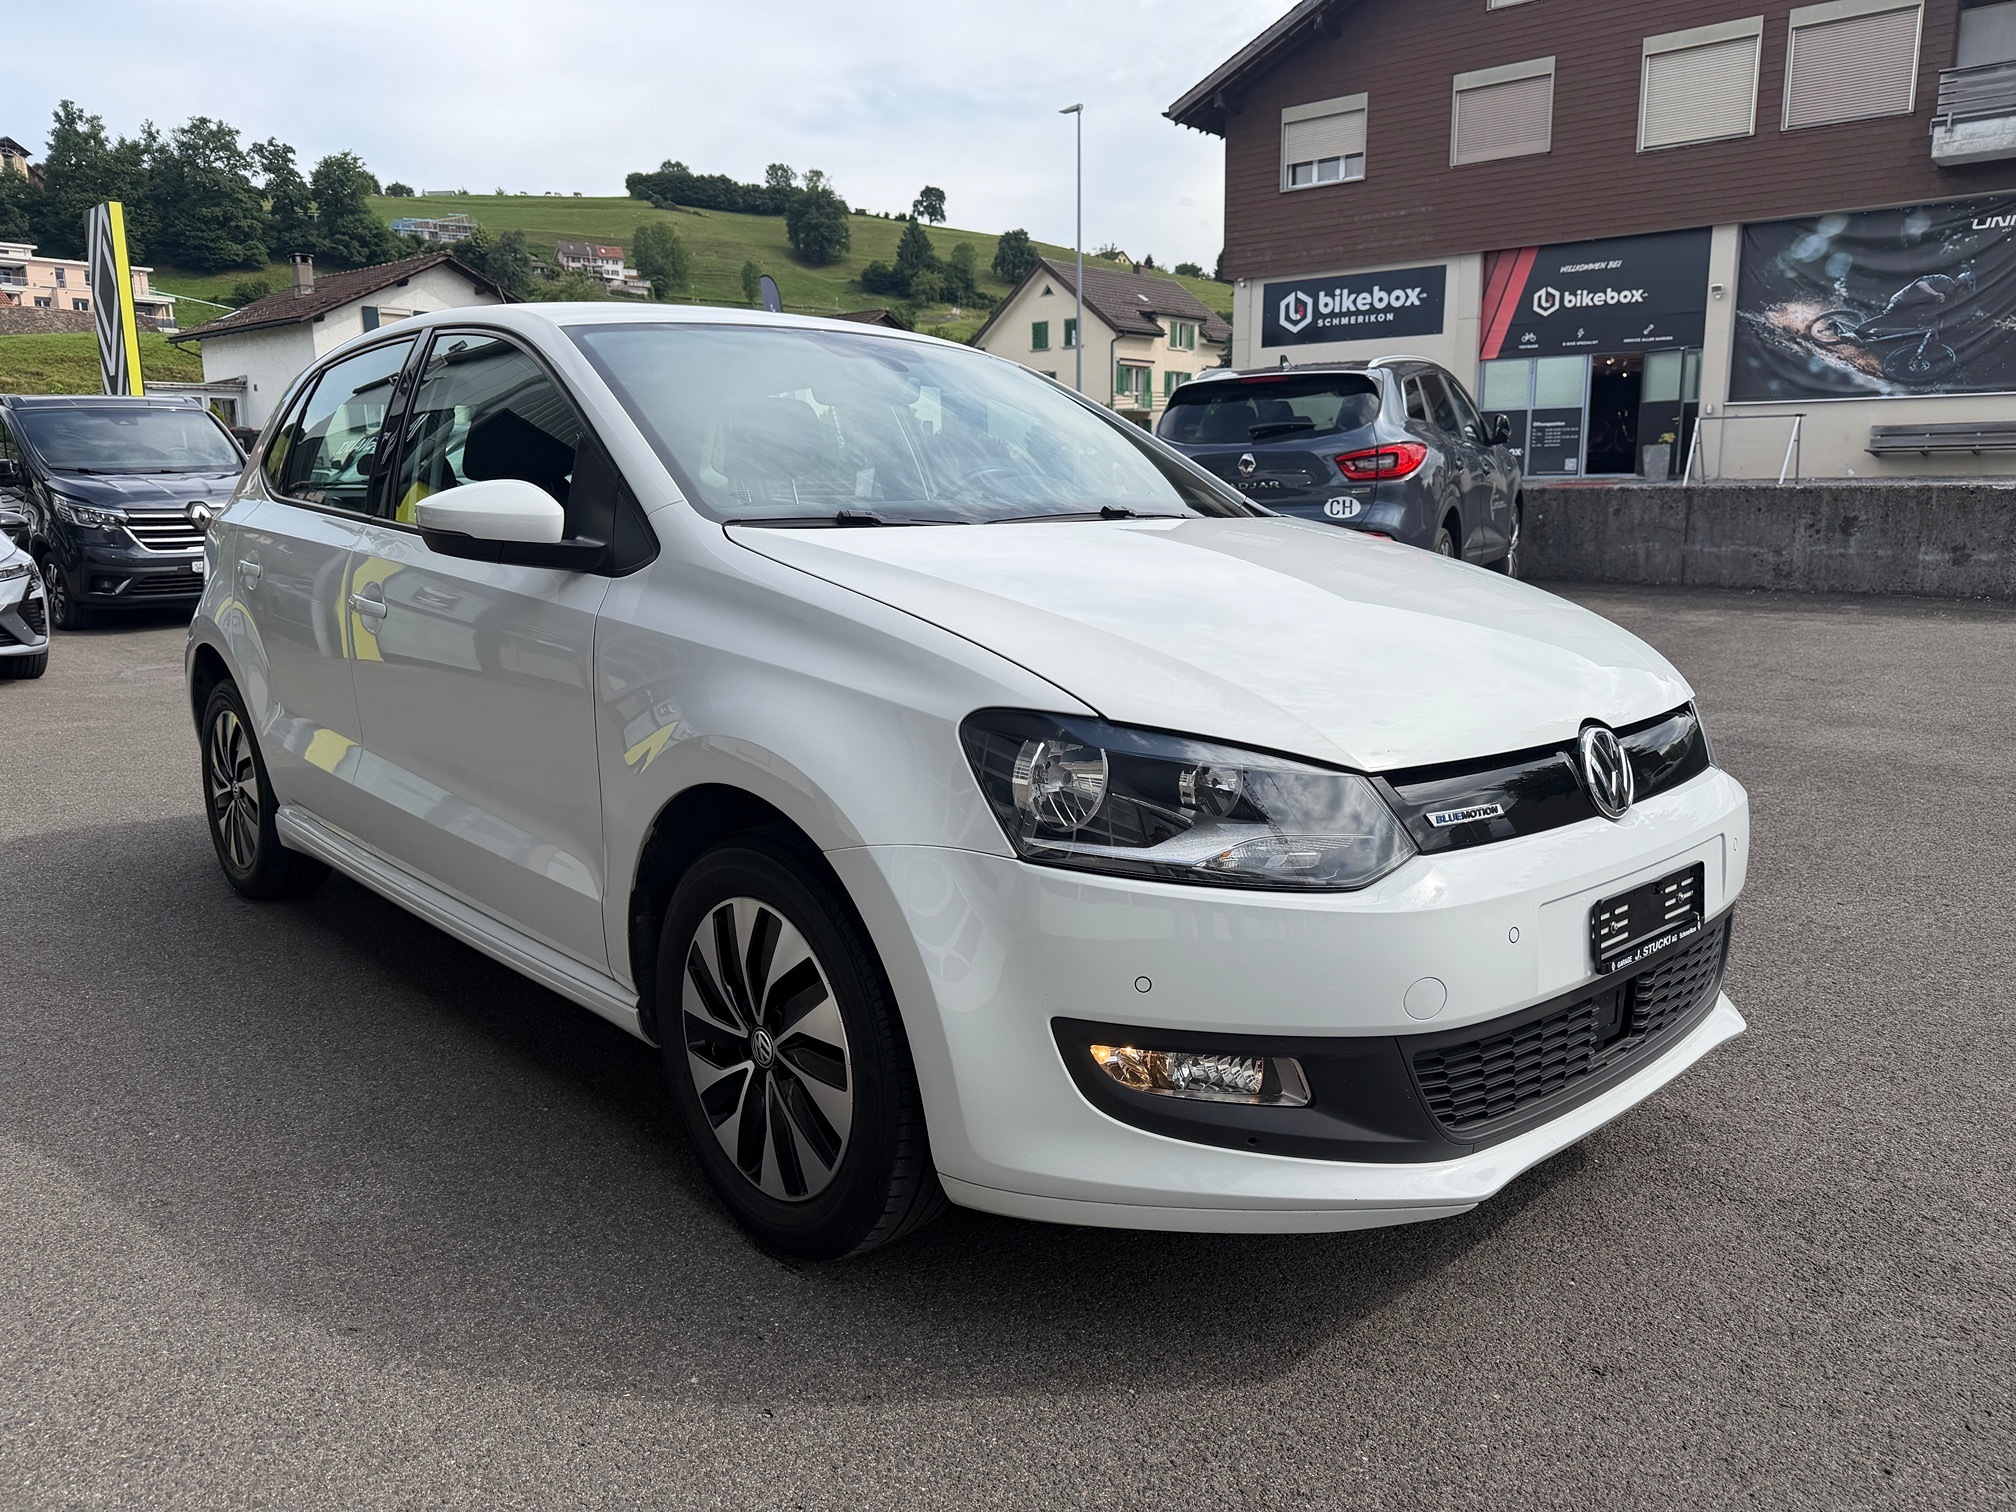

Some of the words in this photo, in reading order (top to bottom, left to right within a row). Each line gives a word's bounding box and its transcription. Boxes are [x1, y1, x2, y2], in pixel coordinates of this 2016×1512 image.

[1607, 260, 1623, 269] BEI
[1317, 312, 1394, 327] SCHMERIKON
[1329, 499, 1353, 516] CH
[1435, 805, 1499, 825] BLUEMOTION
[1617, 955, 1632, 968] GARAGE
[1643, 935, 1671, 957] STUCKI
